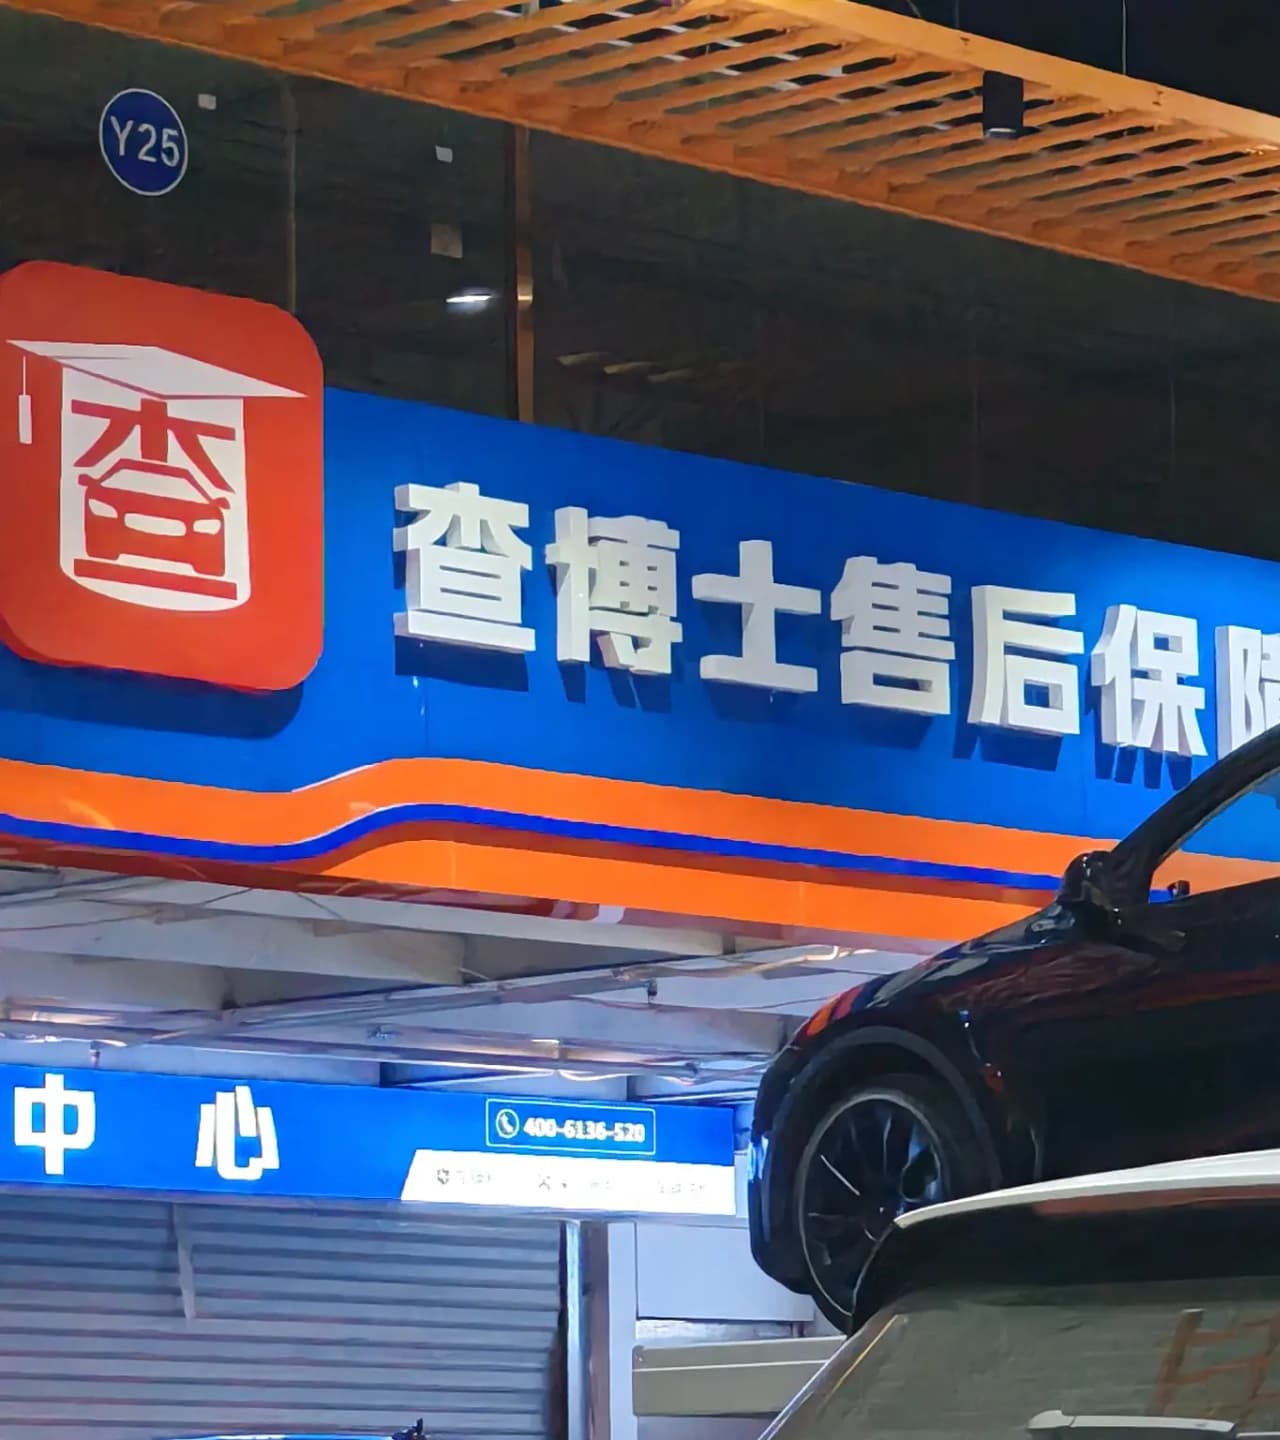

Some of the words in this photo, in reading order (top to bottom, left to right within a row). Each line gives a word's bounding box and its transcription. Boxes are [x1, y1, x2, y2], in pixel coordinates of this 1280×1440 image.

[110, 115, 180, 167] Y25
[13, 1072, 281, 1181] 中心
[523, 1116, 646, 1143] 400-6136-520
